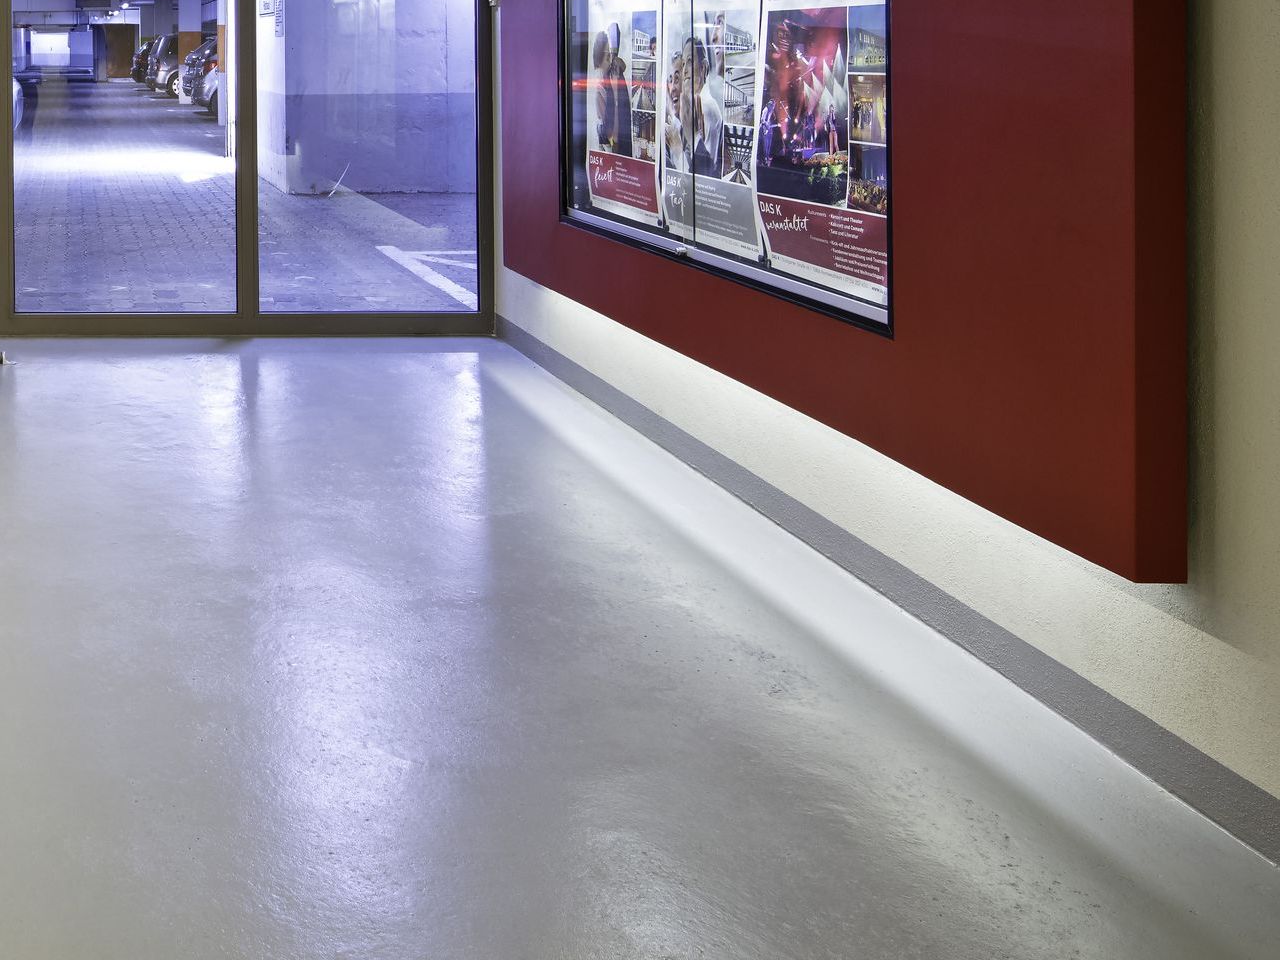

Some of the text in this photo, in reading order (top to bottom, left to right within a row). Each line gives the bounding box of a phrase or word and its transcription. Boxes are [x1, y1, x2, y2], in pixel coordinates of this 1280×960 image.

[590, 155, 599, 165] DAS
[666, 175, 677, 186] DAS
[760, 200, 783, 216] DAS K
